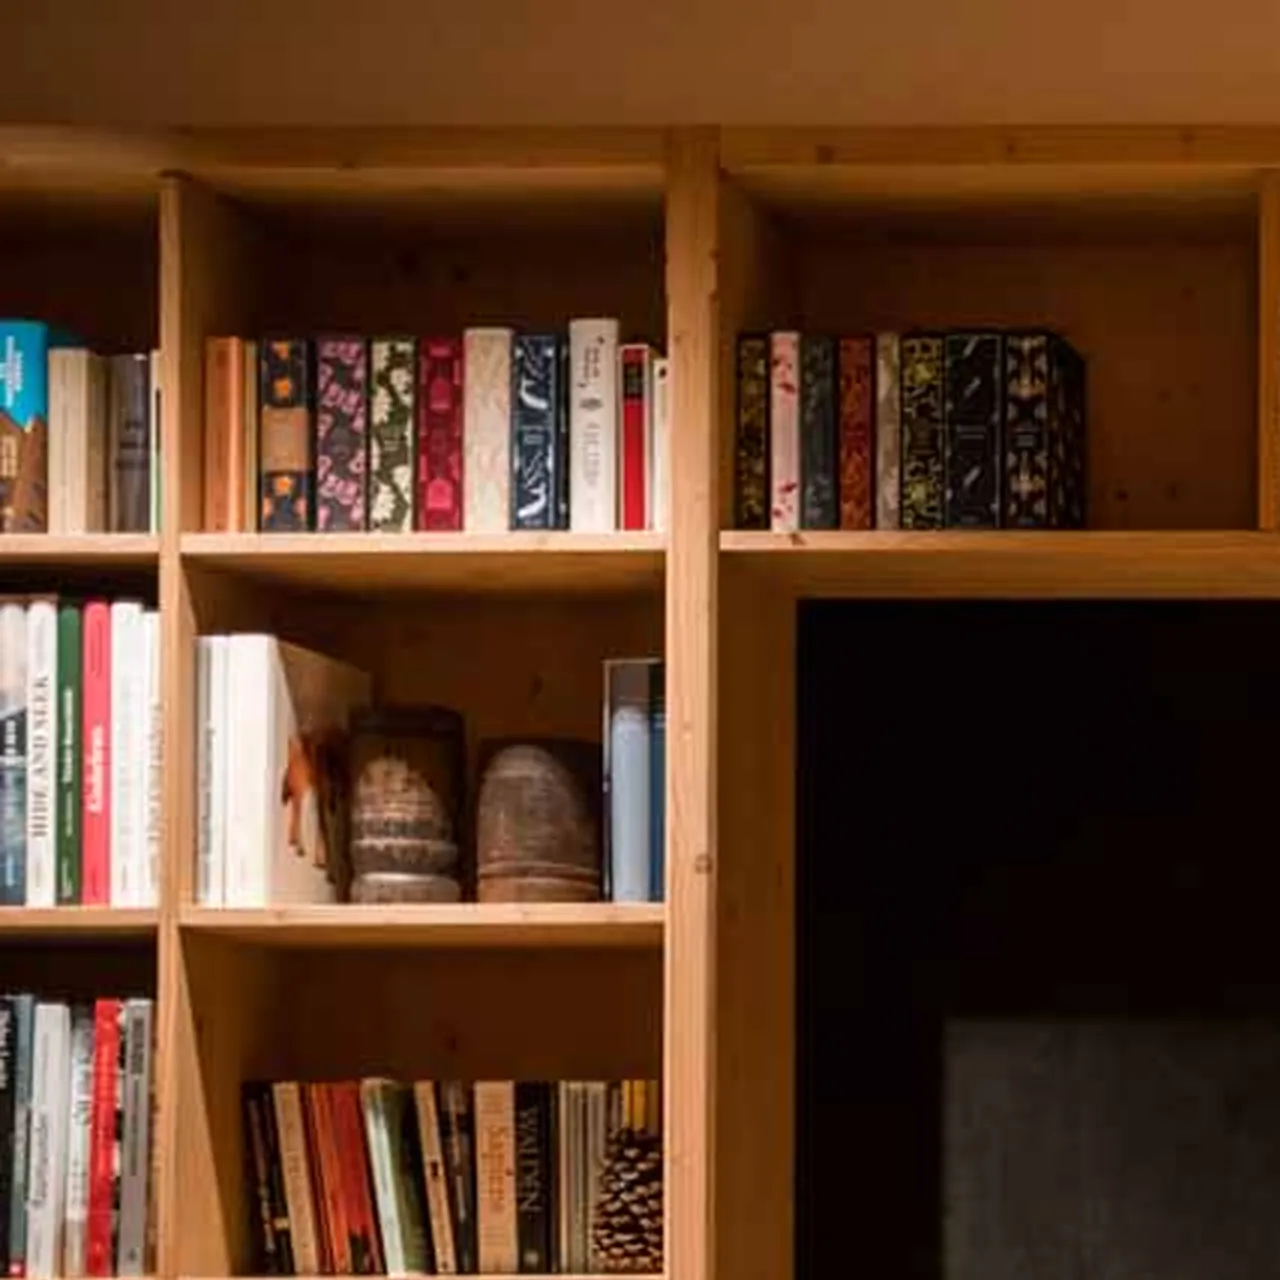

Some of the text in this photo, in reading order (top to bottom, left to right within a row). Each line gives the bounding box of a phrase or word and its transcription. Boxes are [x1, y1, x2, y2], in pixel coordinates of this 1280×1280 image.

[31, 736, 49, 779] AND
[31, 790, 49, 838] HIDE
[519, 1105, 543, 1214] WALDEN
